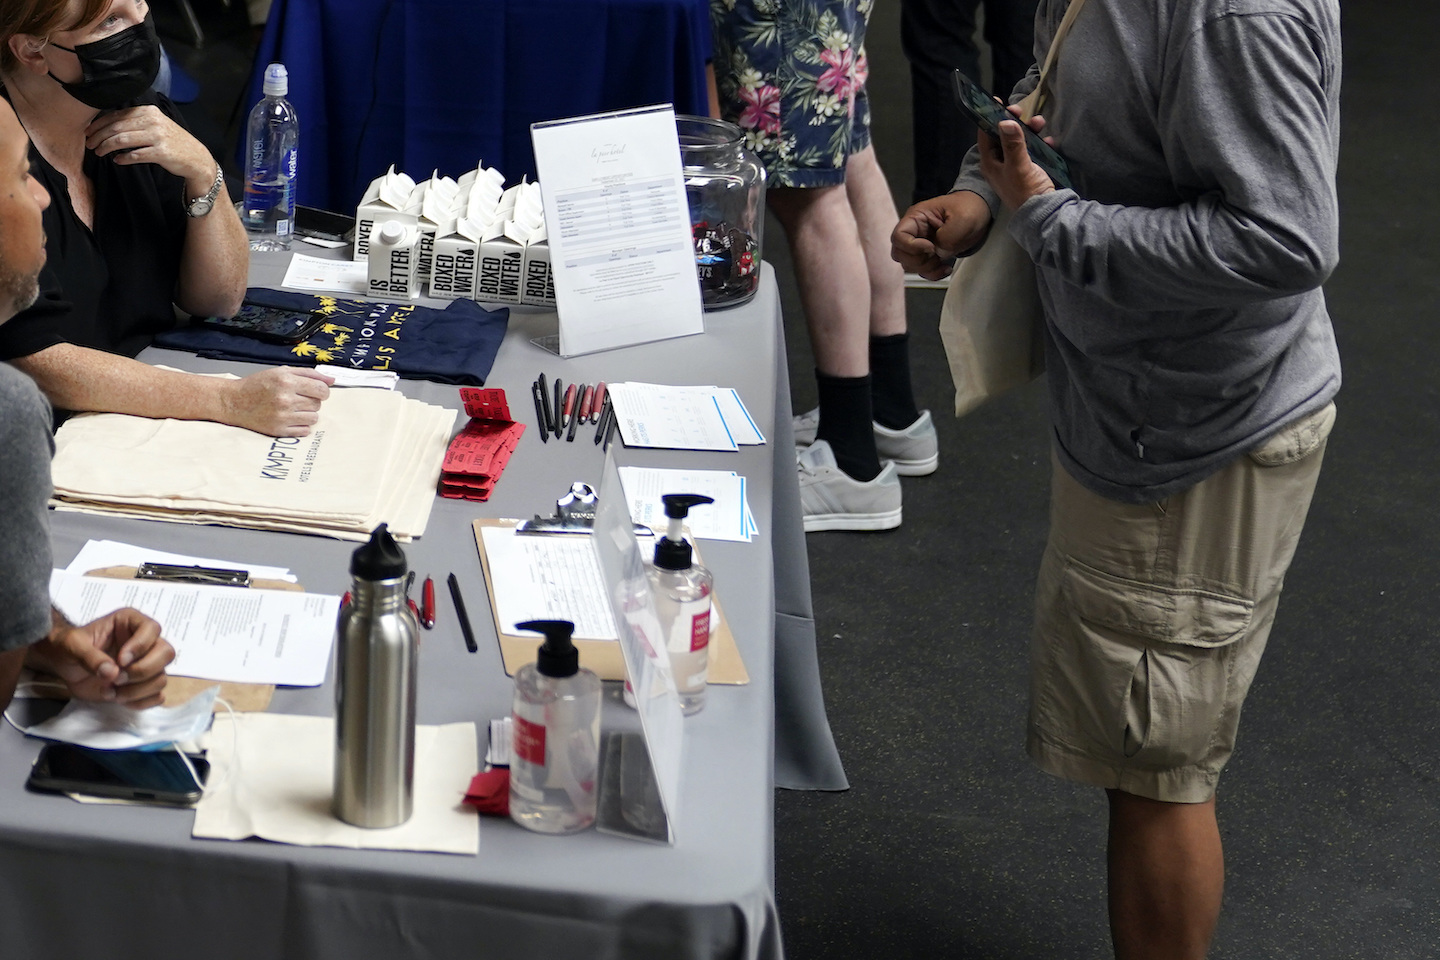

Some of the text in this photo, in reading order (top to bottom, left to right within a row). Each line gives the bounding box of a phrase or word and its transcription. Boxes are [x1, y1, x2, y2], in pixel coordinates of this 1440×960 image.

[370, 279, 388, 291] IS
[390, 248, 410, 293] BETTER.
[434, 254, 455, 292] BOXED
[453, 258, 474, 293] WATER
[480, 257, 501, 295] BOXED
[499, 260, 521, 296] WATER
[527, 260, 547, 298] BOXED
[259, 437, 300, 480] KIMPTO
